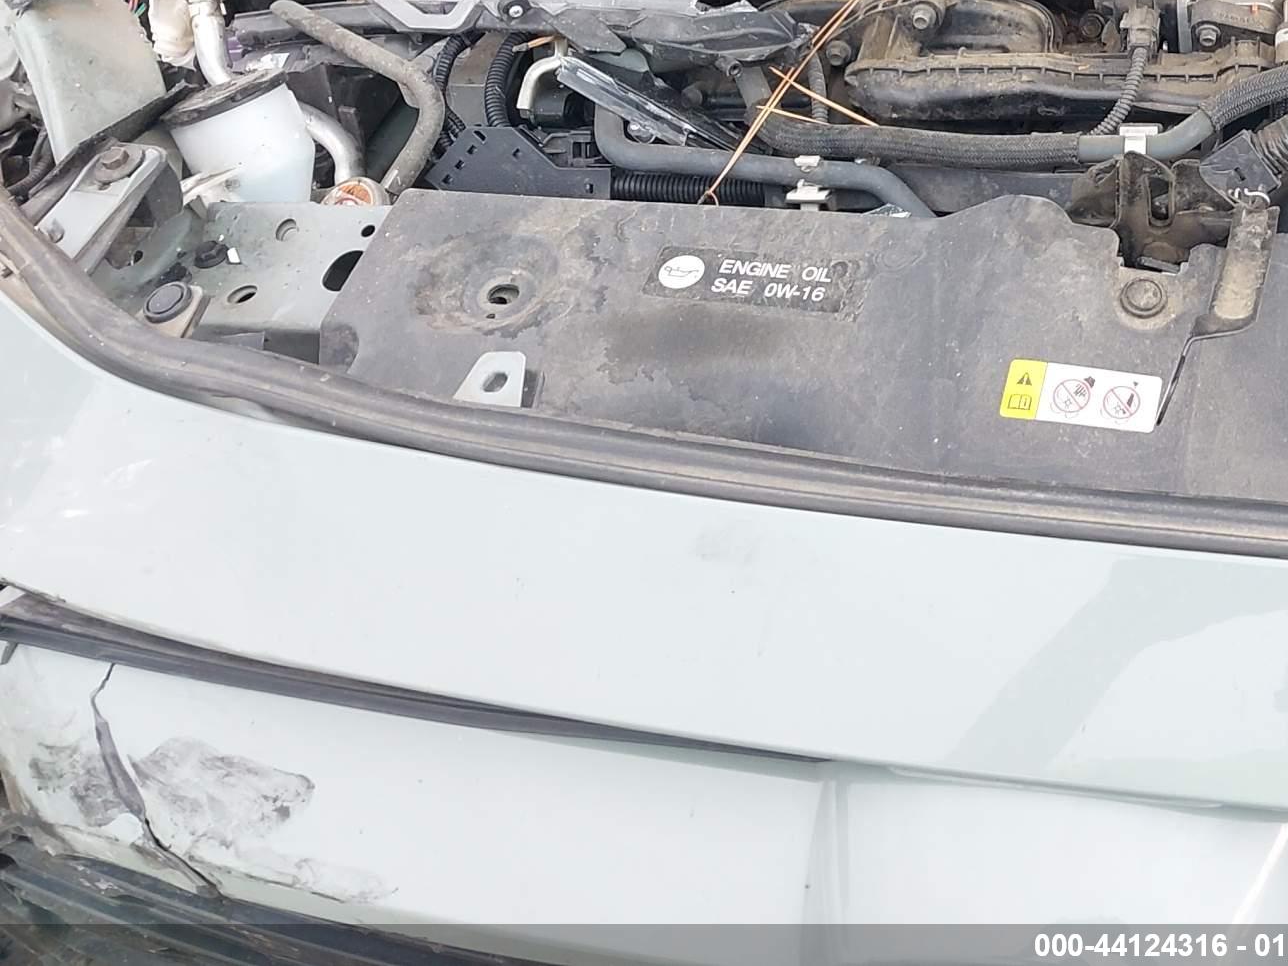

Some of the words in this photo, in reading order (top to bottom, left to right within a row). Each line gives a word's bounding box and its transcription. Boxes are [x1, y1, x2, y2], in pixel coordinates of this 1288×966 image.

[719, 259, 792, 278] ENGINE
[801, 266, 832, 283] OIL
[711, 277, 754, 295] SAE
[764, 283, 826, 301] 0W-16
